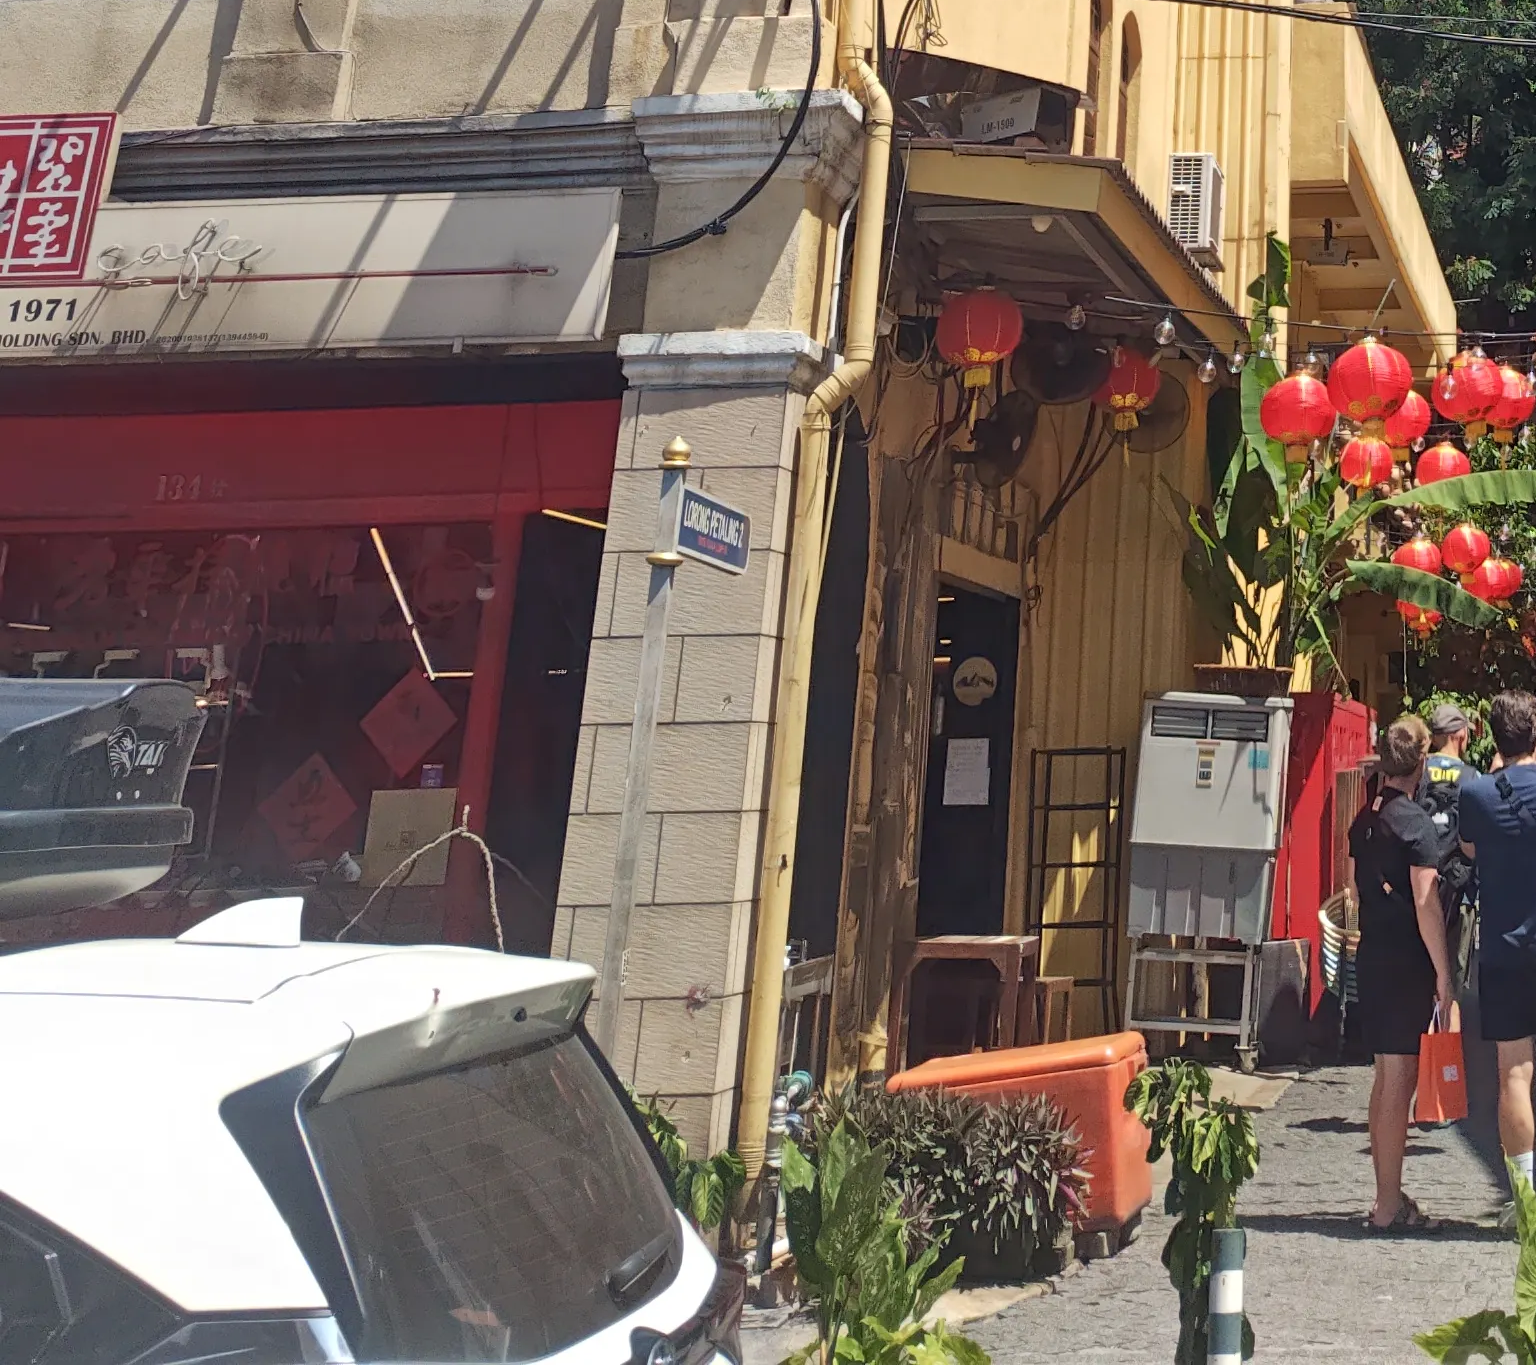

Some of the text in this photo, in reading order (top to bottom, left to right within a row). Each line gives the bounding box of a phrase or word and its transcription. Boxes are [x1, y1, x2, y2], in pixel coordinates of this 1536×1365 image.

[9, 298, 78, 322] 1971
[67, 332, 105, 346] SDN.
[111, 329, 150, 345] BHD.
[684, 499, 711, 535] LORONG
[710, 510, 740, 545] PETALING
[738, 522, 745, 548] 2
